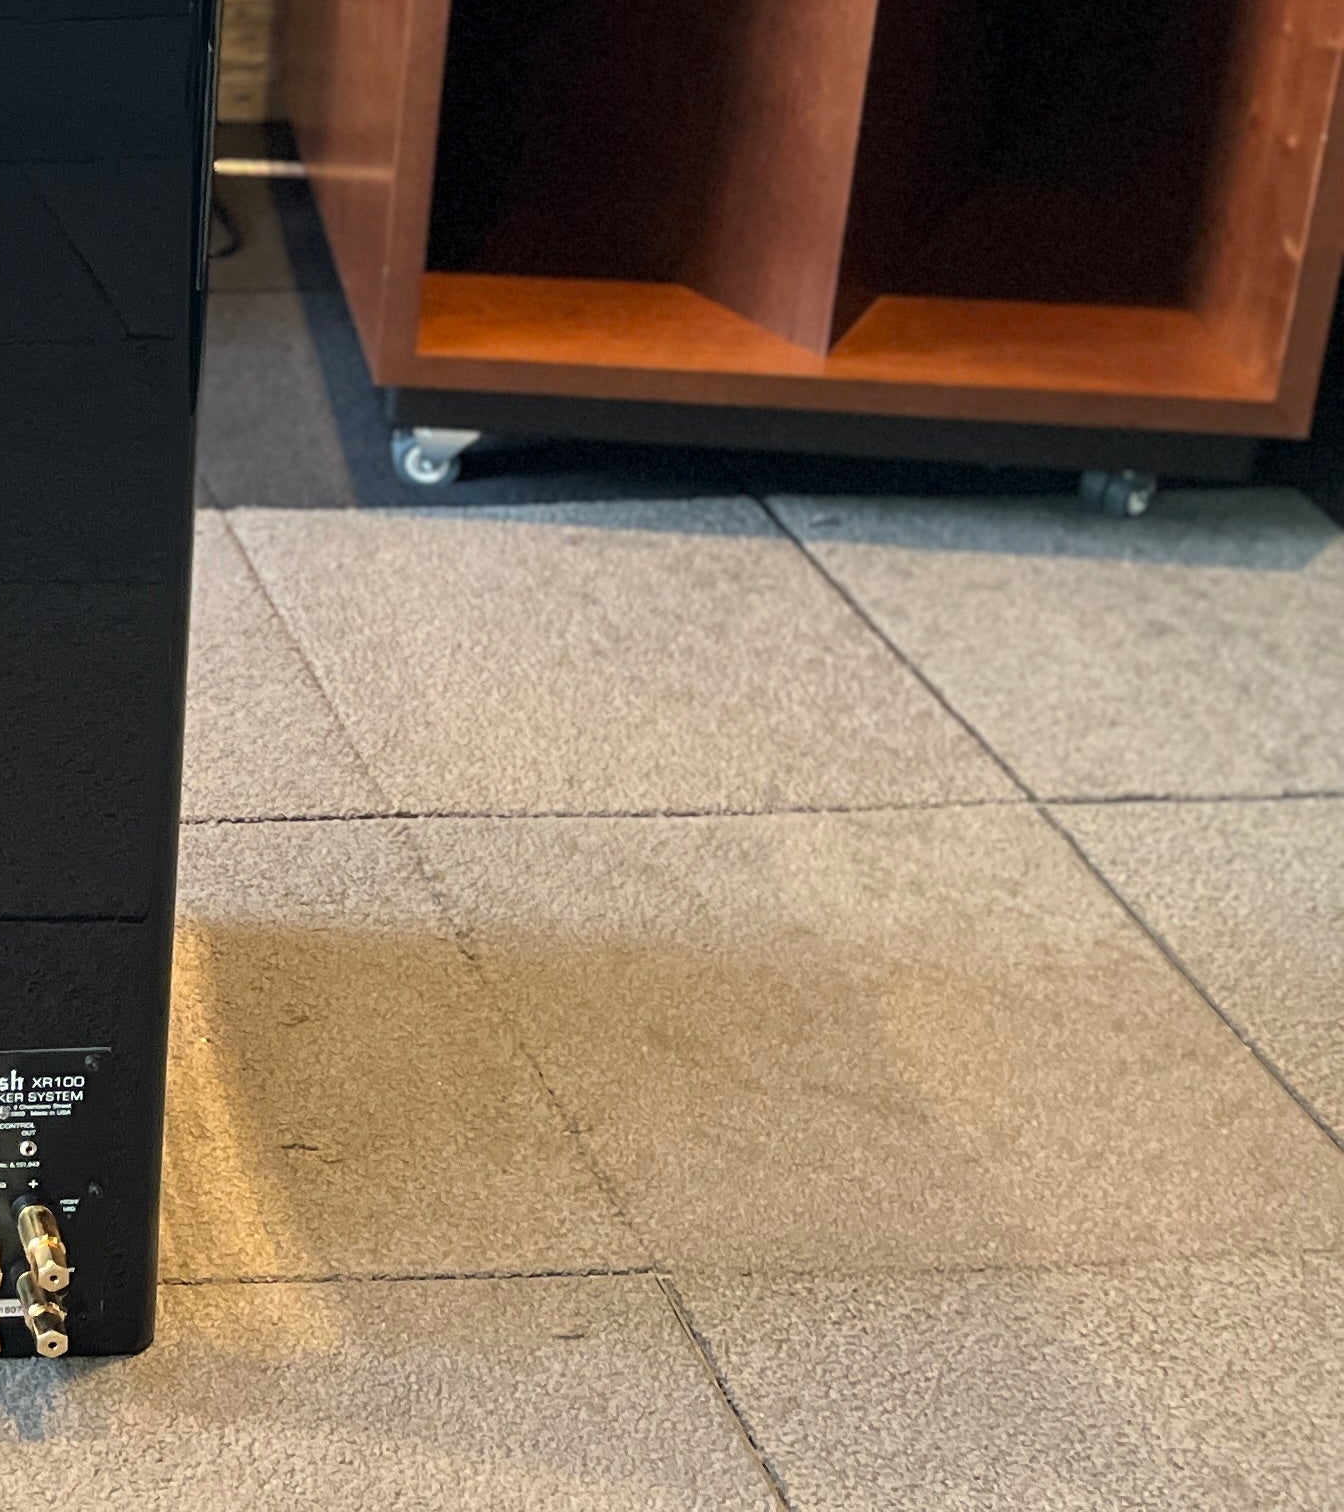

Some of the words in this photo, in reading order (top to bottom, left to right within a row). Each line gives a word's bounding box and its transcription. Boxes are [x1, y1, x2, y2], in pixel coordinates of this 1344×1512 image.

[32, 1076, 85, 1088] XR100
[27, 1090, 84, 1102] SYSTEM
[0, 1122, 35, 1130] CONTROL
[21, 1129, 37, 1137] OUT
